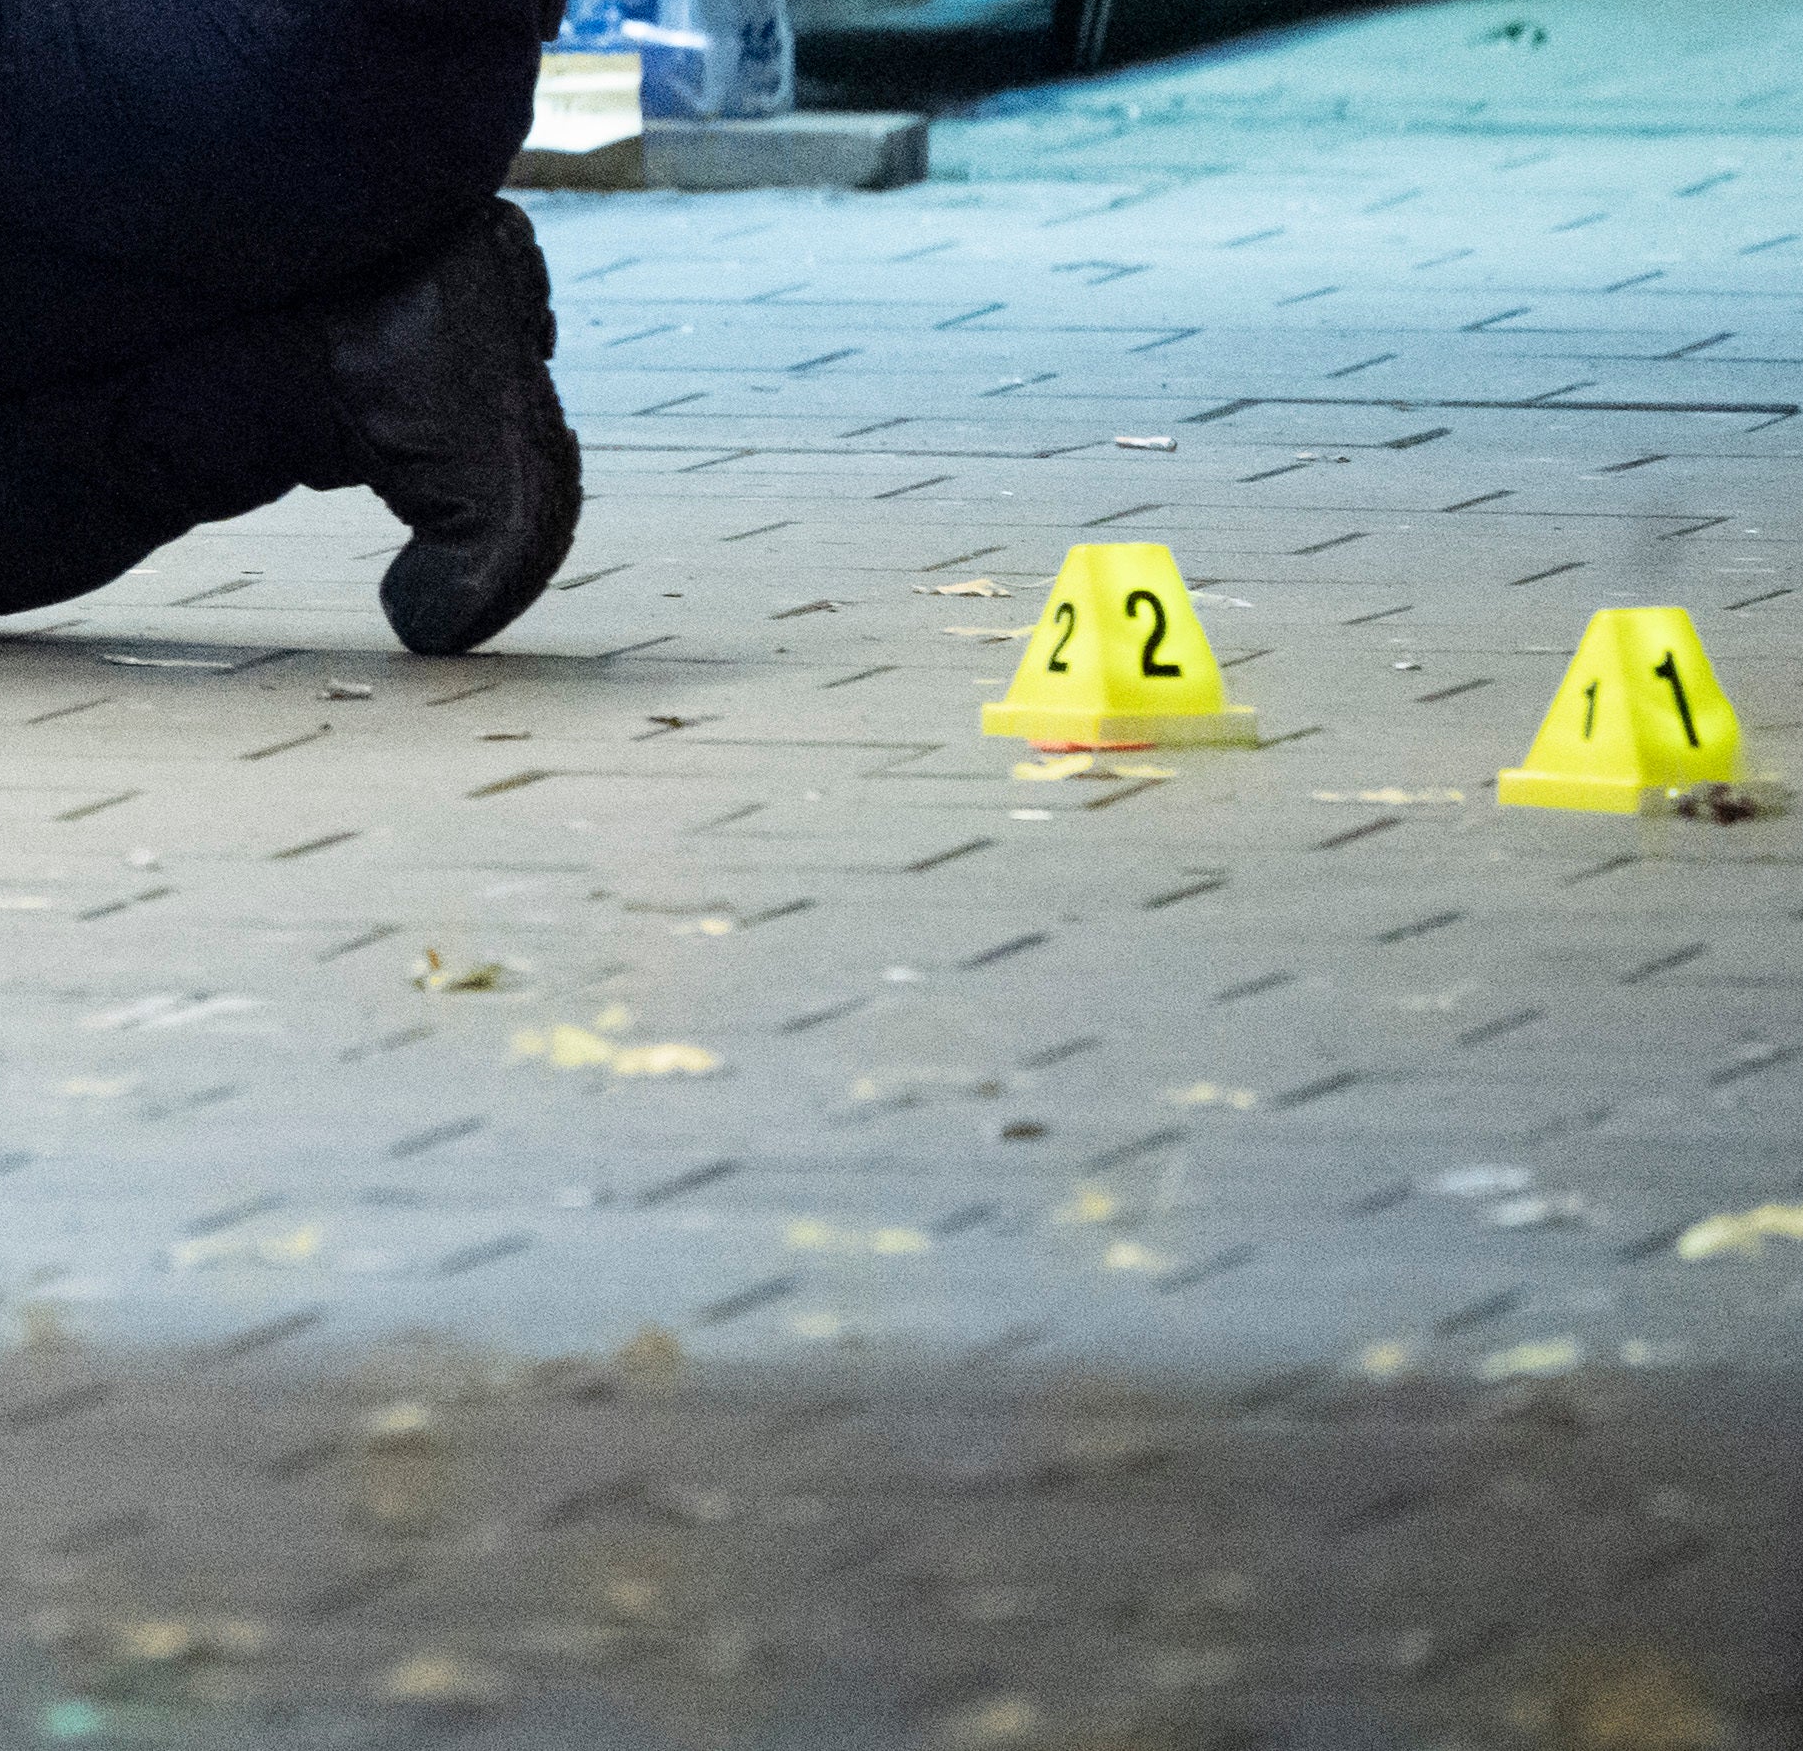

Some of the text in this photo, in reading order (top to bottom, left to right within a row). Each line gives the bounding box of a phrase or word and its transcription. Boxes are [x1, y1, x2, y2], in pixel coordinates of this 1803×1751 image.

[1047, 602, 1076, 672] 2
[1125, 590, 1181, 678] 2
[1584, 680, 1599, 739] 1
[1654, 652, 1699, 749] 1
